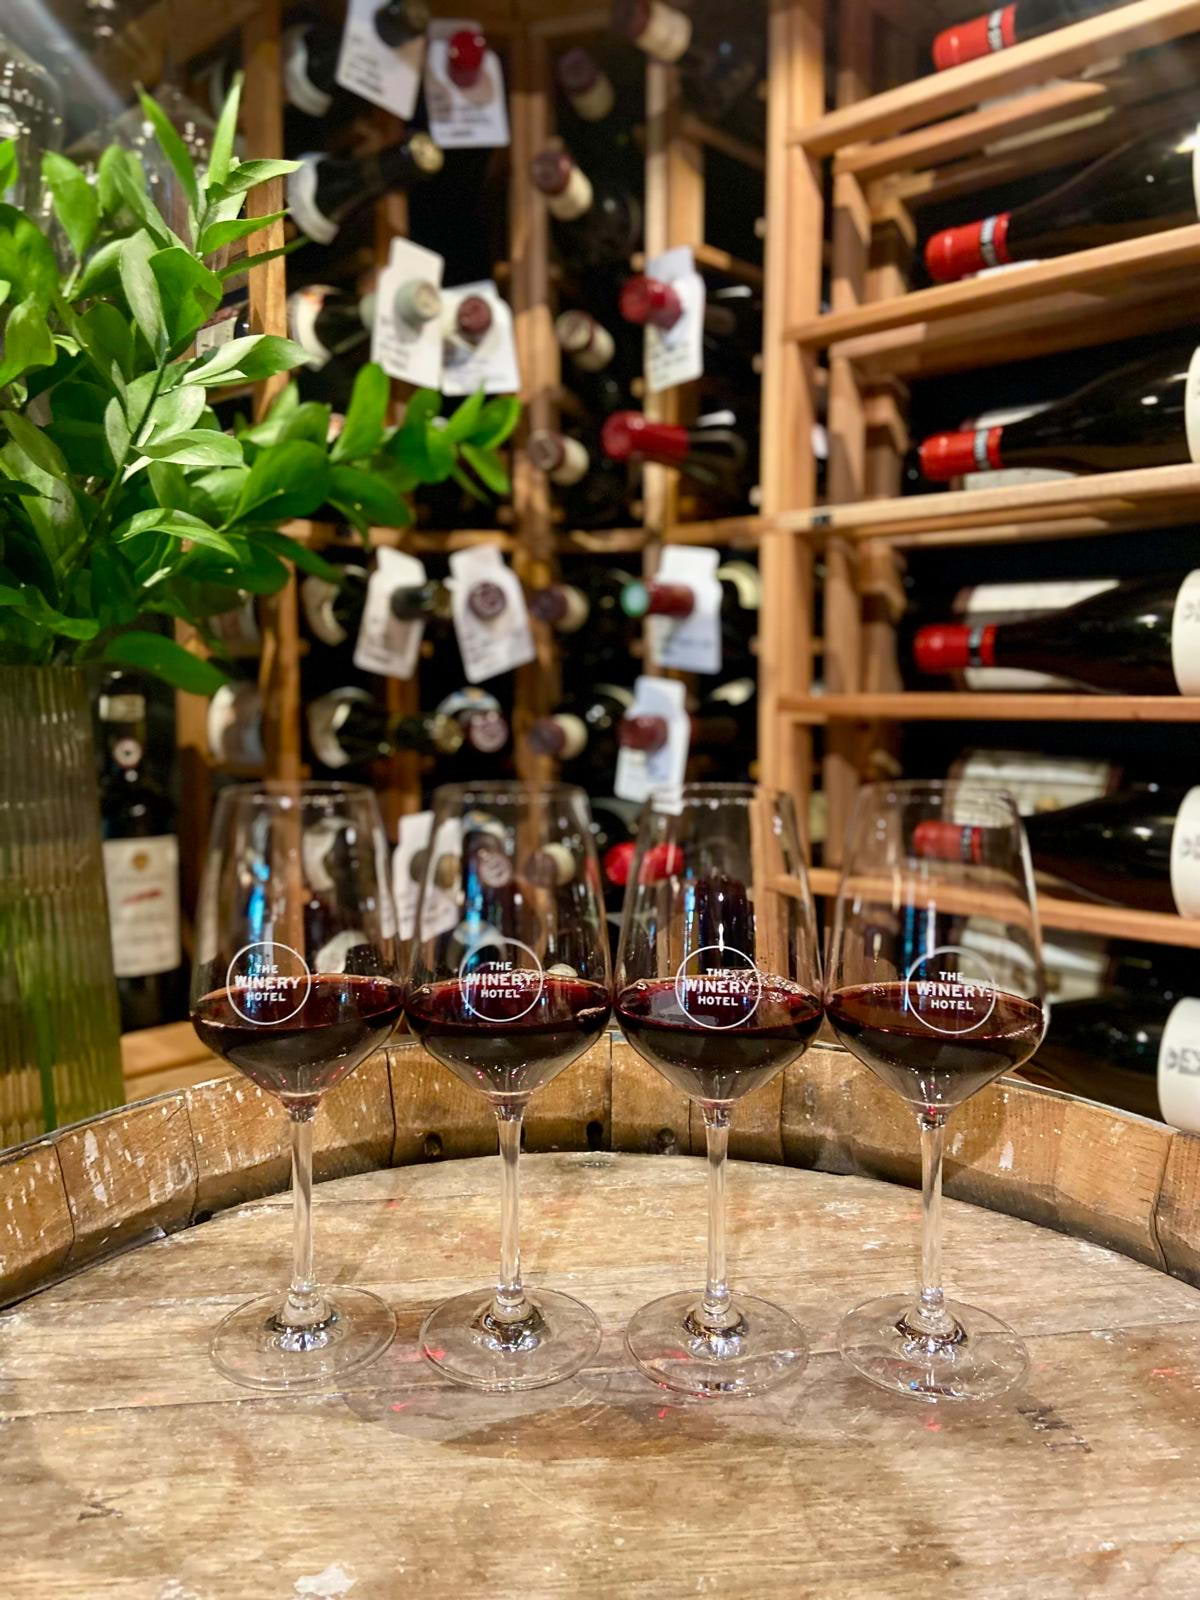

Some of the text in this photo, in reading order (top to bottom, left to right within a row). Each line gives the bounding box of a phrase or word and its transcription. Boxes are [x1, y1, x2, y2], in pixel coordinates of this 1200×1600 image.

[255, 964, 279, 974] THE
[489, 961, 513, 971] THE
[706, 968, 732, 978] THE
[939, 971, 965, 981] THE
[234, 975, 301, 990] WINERY
[465, 973, 533, 987] WINERY
[685, 978, 754, 994] WINERY
[916, 984, 985, 998] WINERY
[246, 992, 286, 1002] HOTEL
[480, 989, 521, 998] HOTEL
[698, 996, 739, 1006] HOTEL
[930, 1000, 974, 1010] HOTEL
